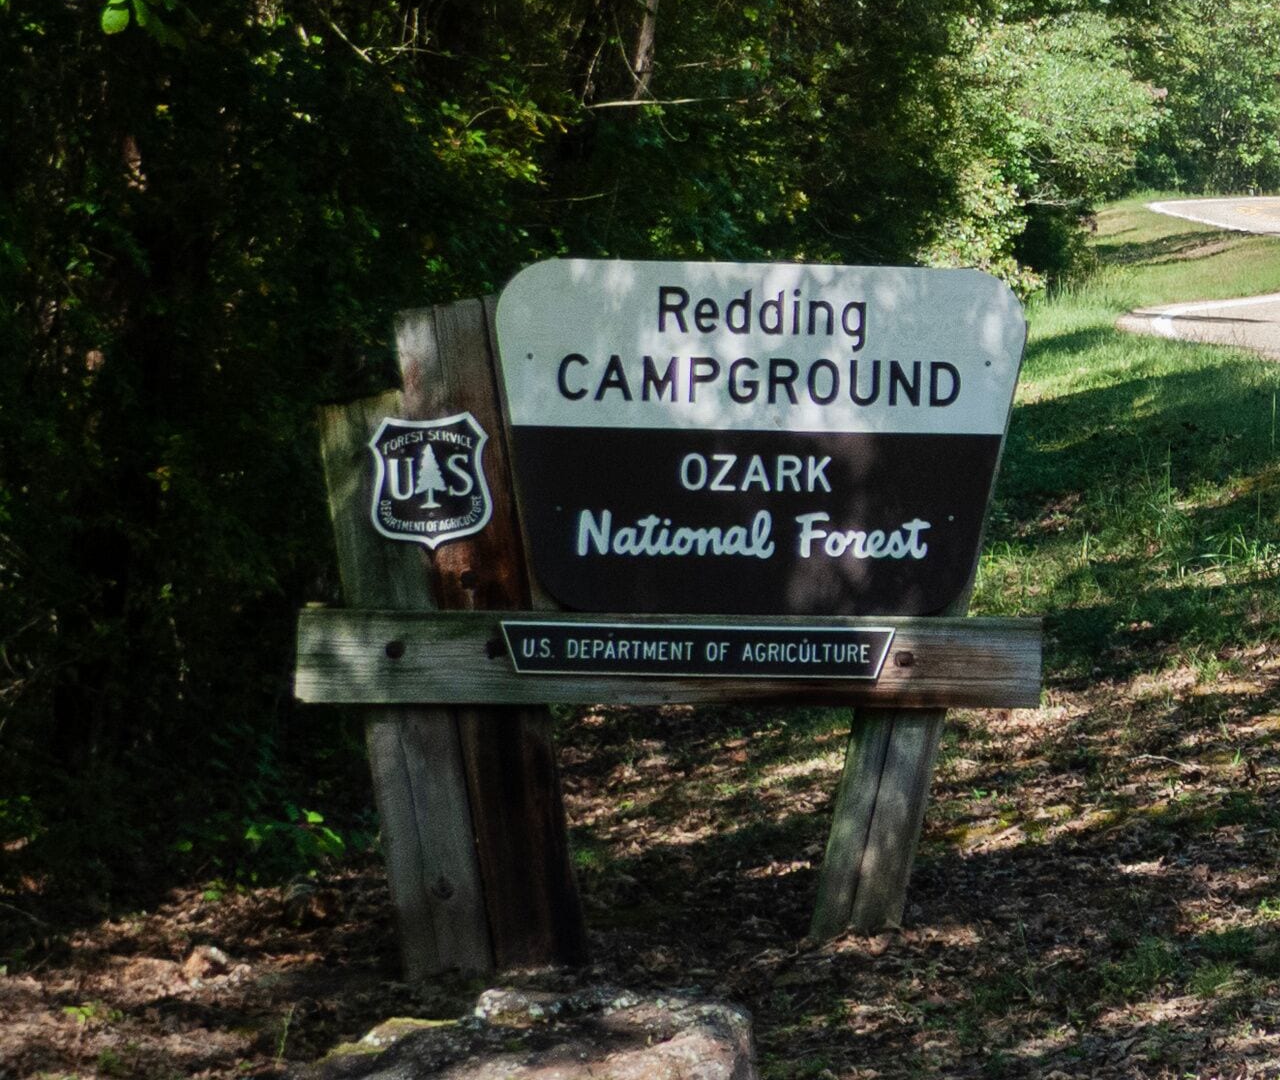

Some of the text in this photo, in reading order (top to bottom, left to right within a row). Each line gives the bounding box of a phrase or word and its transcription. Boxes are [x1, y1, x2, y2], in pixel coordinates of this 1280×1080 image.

[658, 286, 867, 352] Redding
[556, 354, 962, 407] CAMPGROUND
[382, 430, 473, 455] FOREST SERVICE
[680, 454, 832, 493] OZARK
[577, 510, 929, 560] National Forest
[522, 638, 871, 664] U.S. DEPARTMENT OF AGRICULTURE
